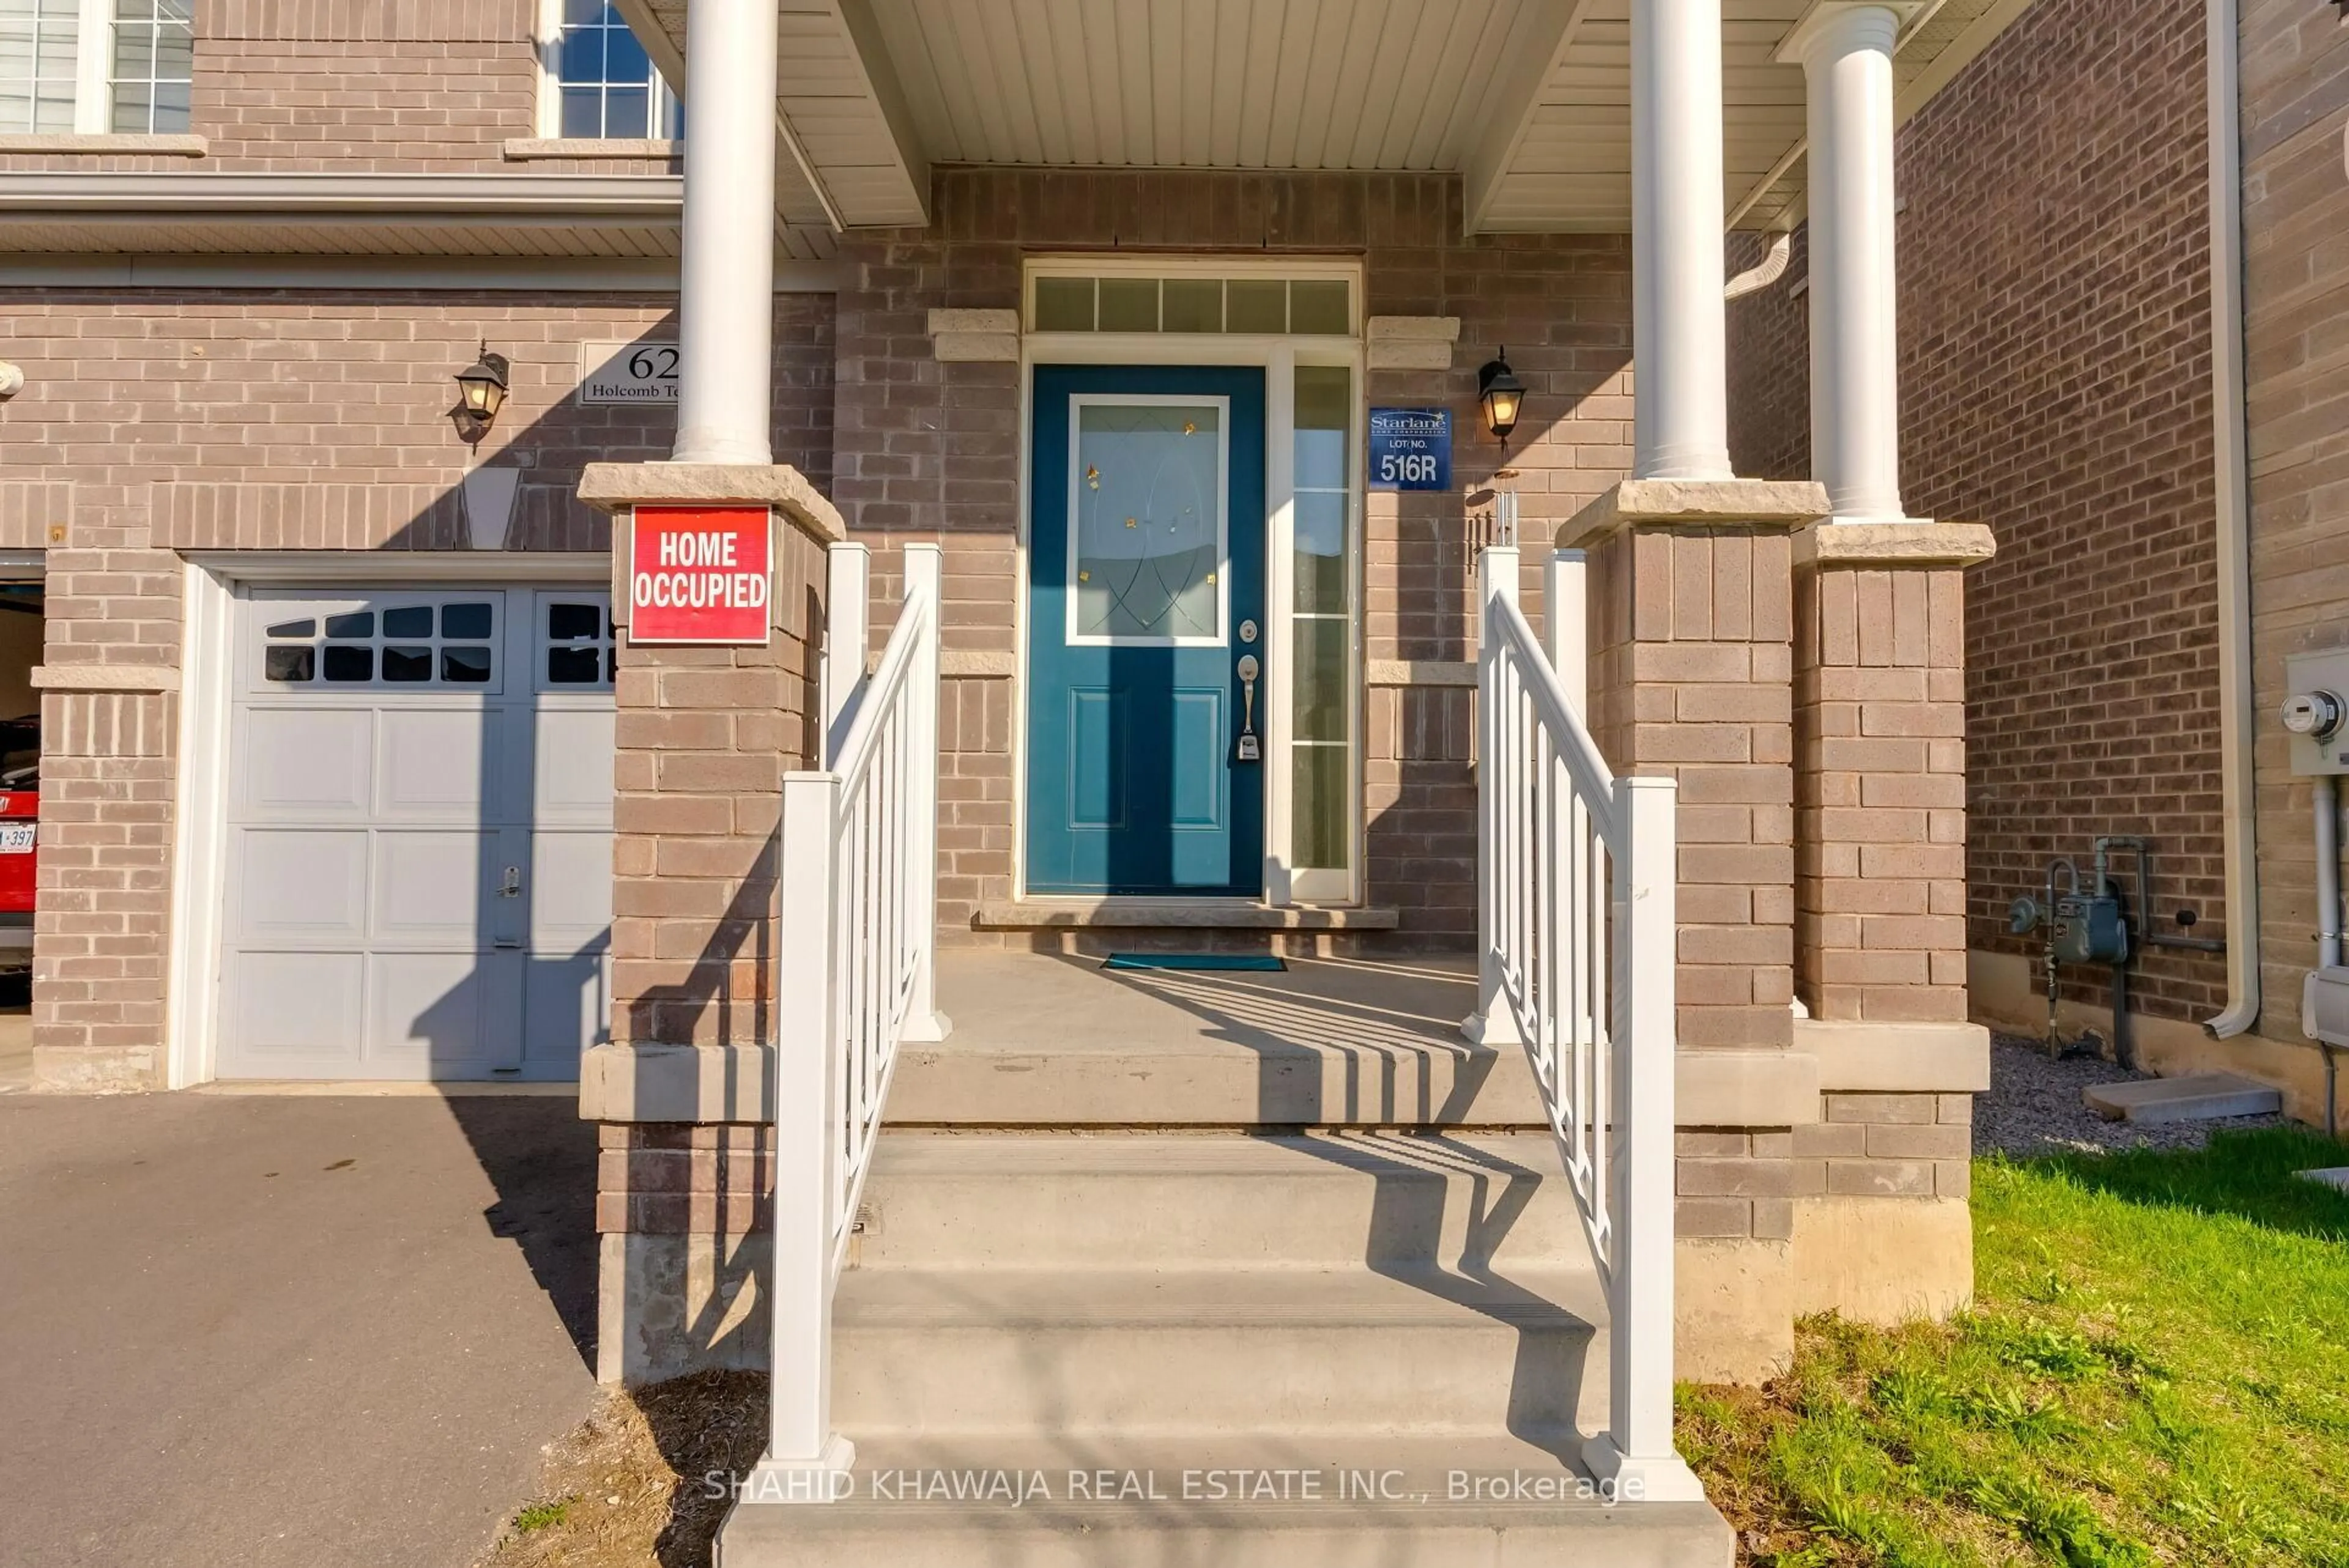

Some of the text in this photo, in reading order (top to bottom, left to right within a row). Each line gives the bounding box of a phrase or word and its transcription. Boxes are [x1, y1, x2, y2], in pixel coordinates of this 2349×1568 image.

[629, 347, 679, 379] 62
[592, 384, 659, 397] Holcomb
[1371, 416, 1446, 428] Starlane
[1389, 440, 1428, 449] LOT NO.
[1380, 454, 1436, 482] 516R
[659, 531, 738, 567] HOME
[634, 572, 766, 608] OCCUPIED
